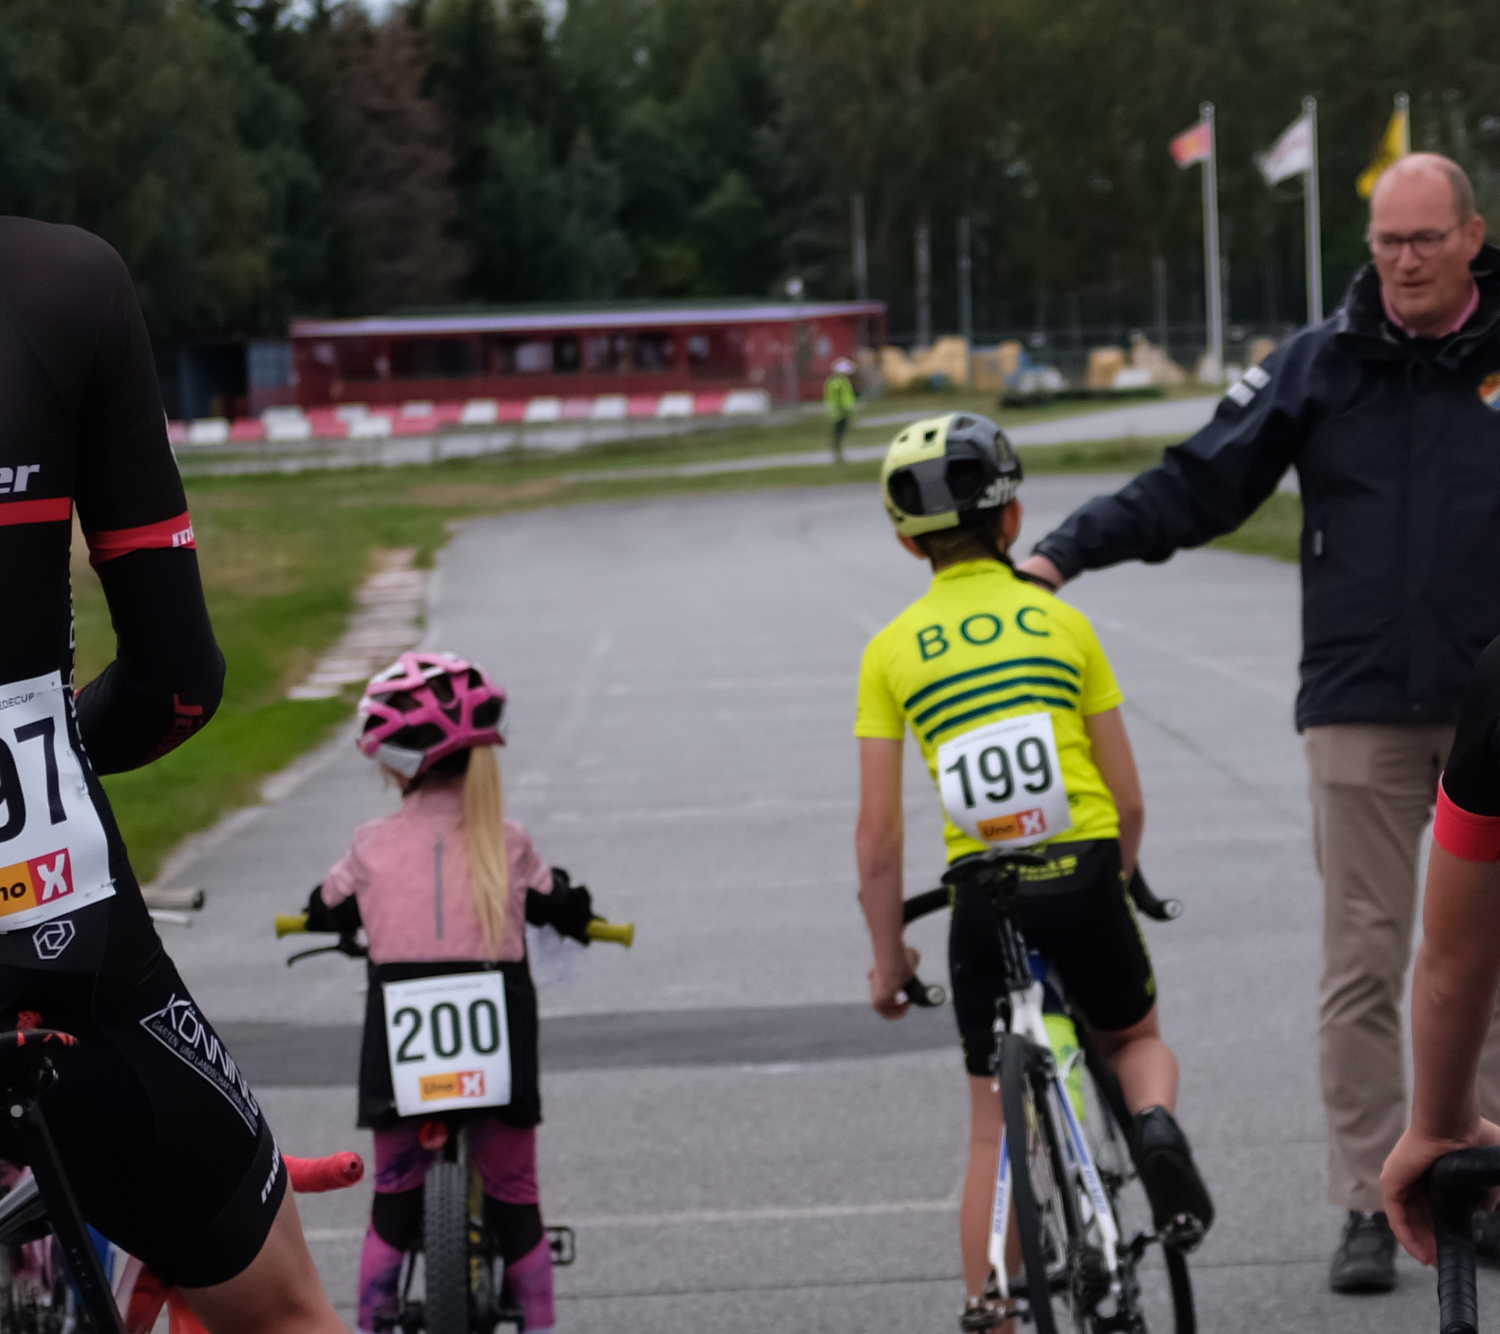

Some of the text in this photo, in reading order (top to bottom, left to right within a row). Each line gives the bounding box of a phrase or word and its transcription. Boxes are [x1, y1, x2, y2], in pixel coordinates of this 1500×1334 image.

[916, 605, 1052, 663] BOC
[945, 735, 1053, 810] 199
[1021, 809, 1043, 834] X
[37, 852, 68, 901] X
[392, 998, 501, 1065] 200
[461, 1073, 483, 1097] X
